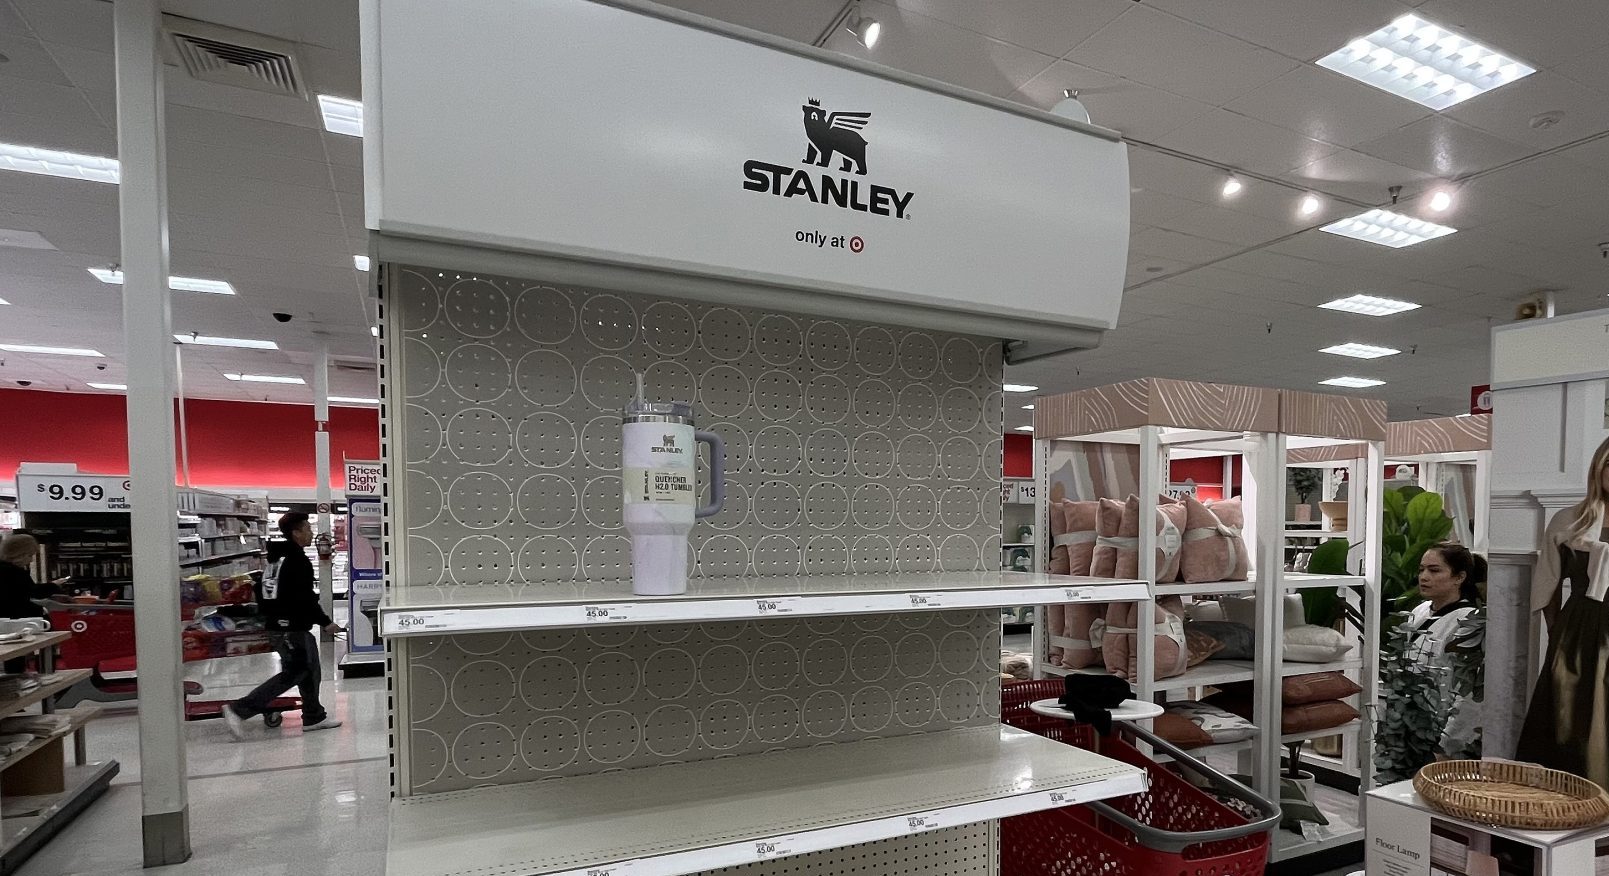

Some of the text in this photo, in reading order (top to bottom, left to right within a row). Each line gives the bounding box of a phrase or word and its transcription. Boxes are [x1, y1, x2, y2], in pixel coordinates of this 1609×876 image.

[795, 230, 845, 249] only at
[349, 474, 378, 485] Right
[349, 483, 376, 493] Daily
[107, 502, 132, 510] unde
[398, 617, 425, 626] 45.00
[756, 845, 775, 854] 45.00
[1375, 837, 1421, 860] Floor Lamp
